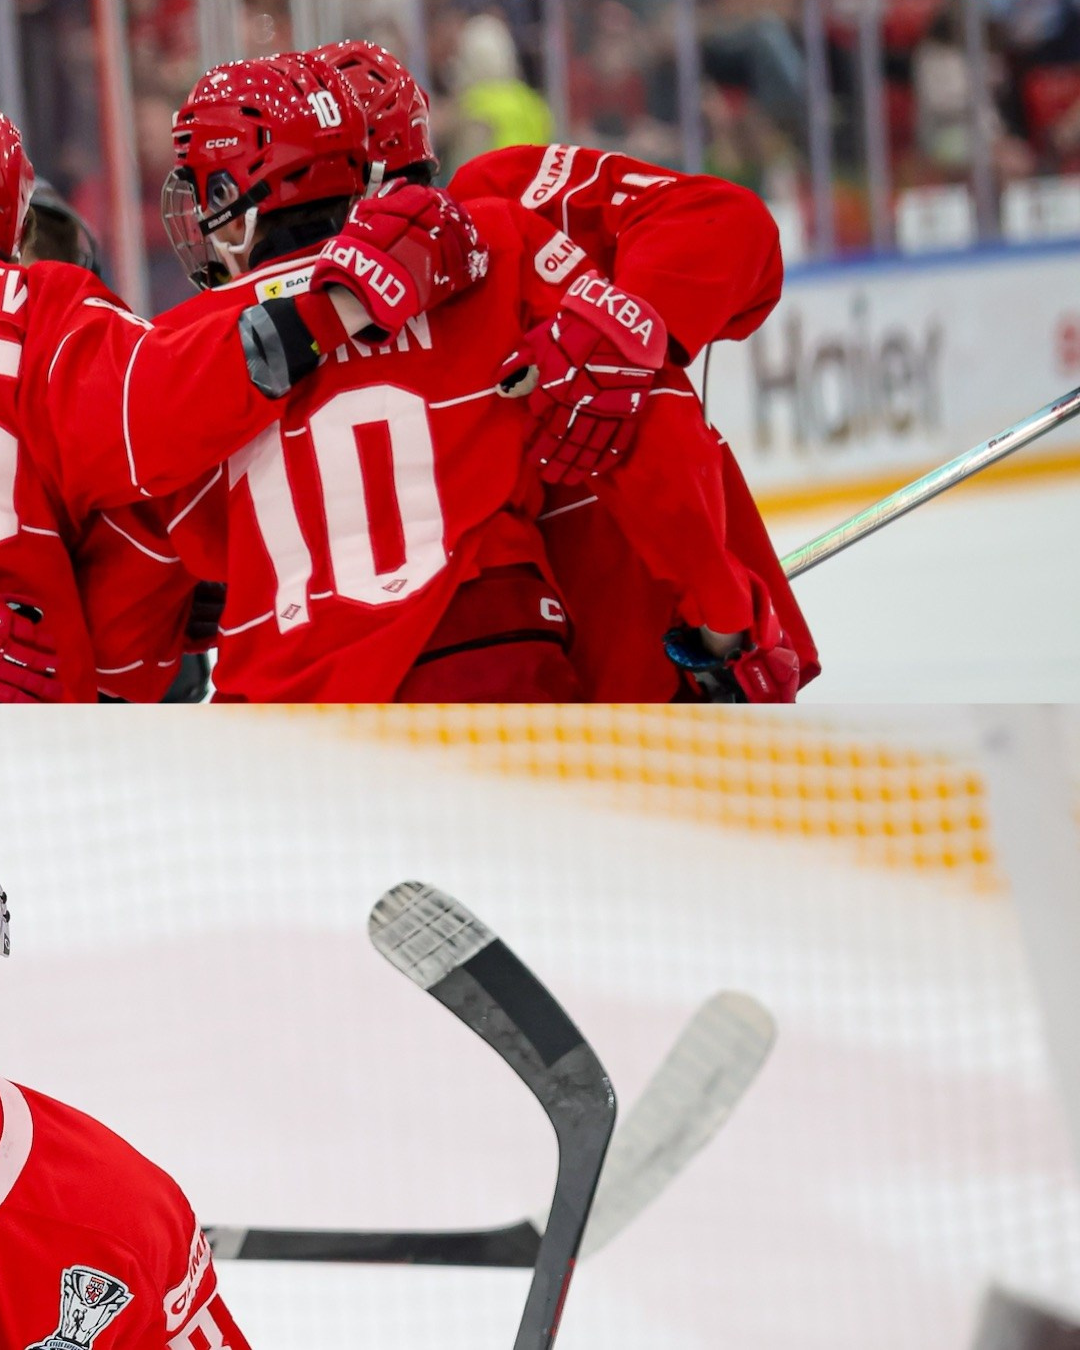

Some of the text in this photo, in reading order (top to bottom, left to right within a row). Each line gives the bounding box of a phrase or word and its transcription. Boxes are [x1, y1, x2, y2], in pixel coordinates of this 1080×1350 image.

[307, 90, 342, 129] 10
[206, 137, 238, 149] CCM
[568, 275, 654, 346] ОСКВА
[228, 385, 448, 635] 10
